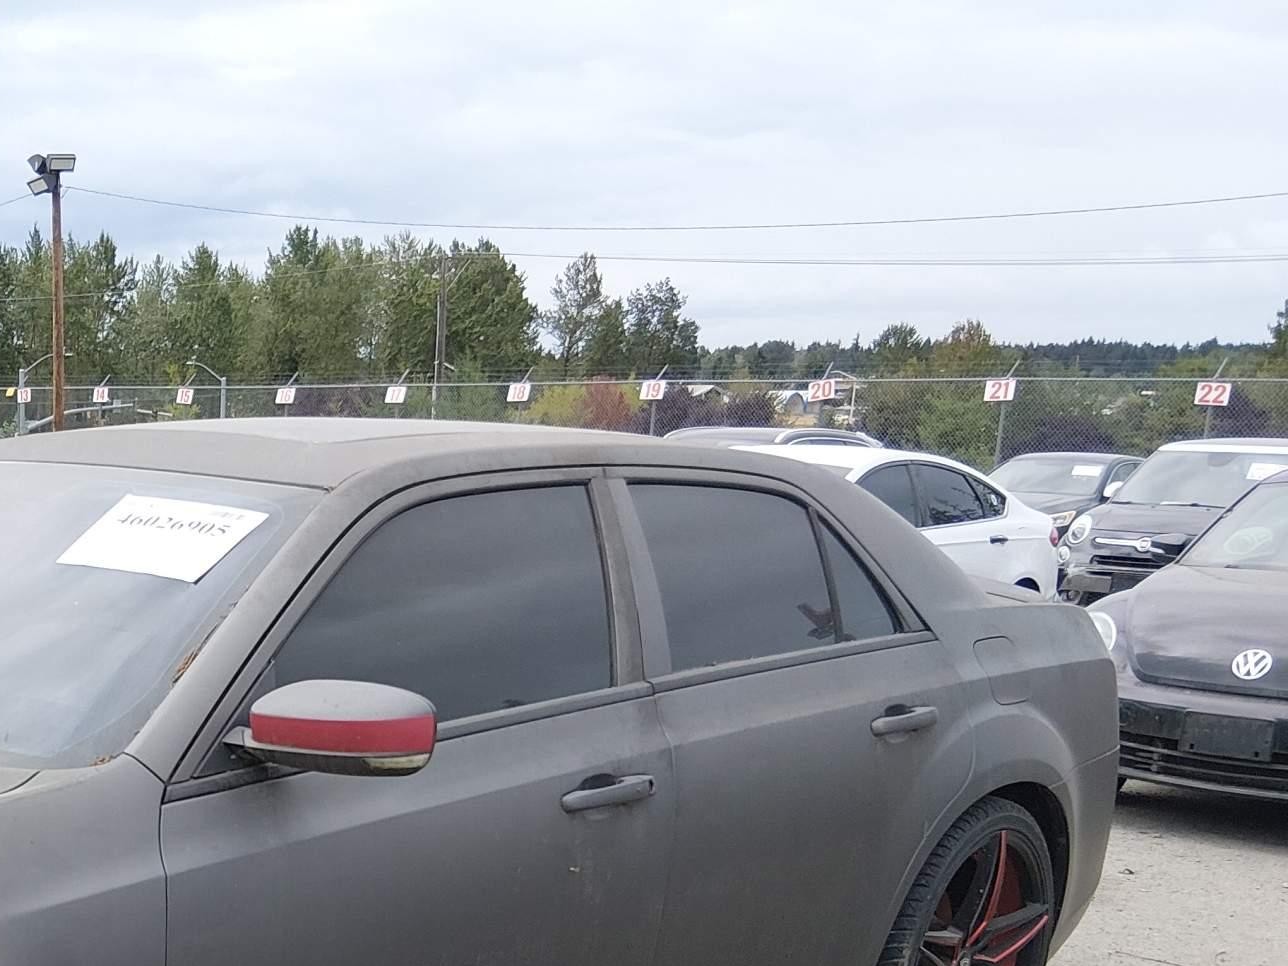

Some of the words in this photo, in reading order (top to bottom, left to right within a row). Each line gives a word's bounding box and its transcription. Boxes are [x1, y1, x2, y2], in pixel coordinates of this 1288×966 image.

[20, 390, 29, 402] 13
[96, 389, 105, 401] 14
[180, 390, 190, 403] 15
[280, 389, 292, 402] 16
[391, 388, 402, 401] 17
[512, 385, 526, 400] 18
[645, 382, 661, 398] 19
[812, 382, 833, 399] 20
[989, 382, 1010, 399] 21
[1198, 383, 1227, 404] 22
[118, 513, 231, 537] 46026905
